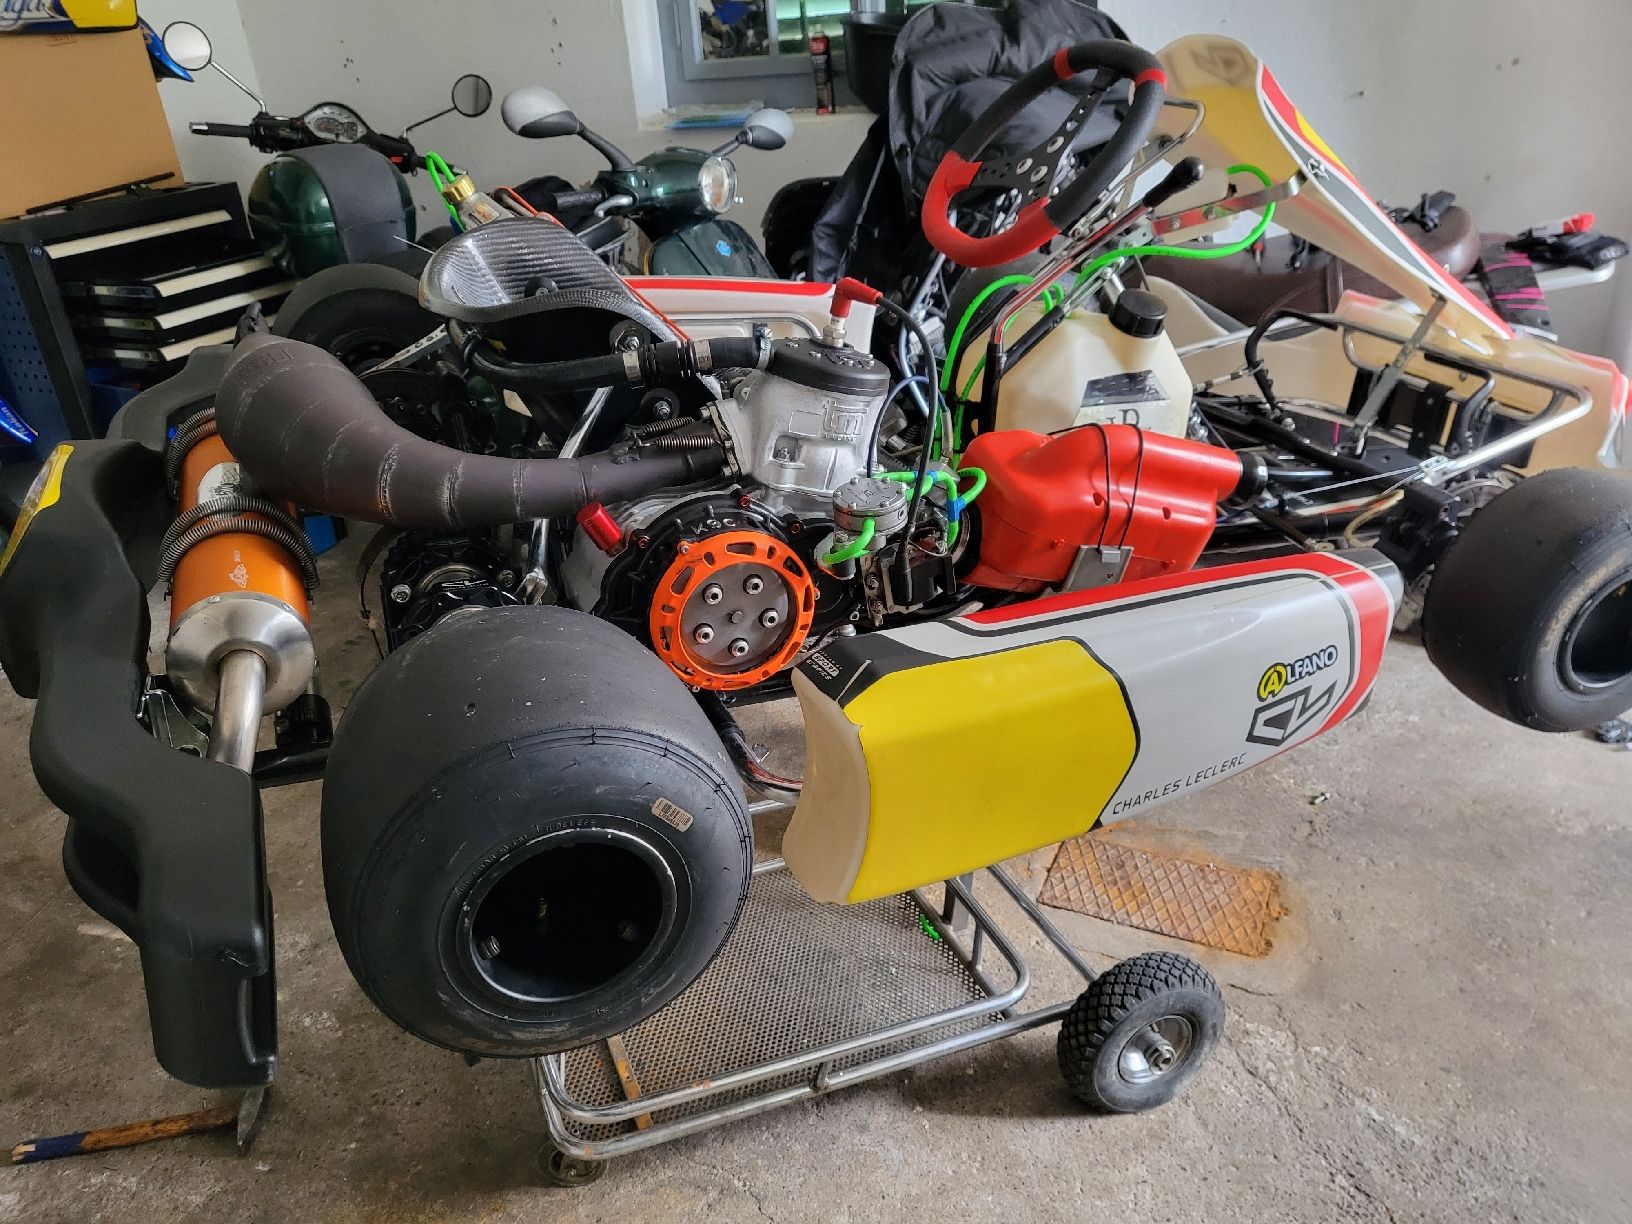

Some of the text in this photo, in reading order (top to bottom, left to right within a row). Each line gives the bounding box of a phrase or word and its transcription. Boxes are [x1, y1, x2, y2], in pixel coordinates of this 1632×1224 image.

[813, 654, 838, 674] SPORT
[1257, 645, 1339, 702] ALFANO
[1112, 752, 1247, 815] CHARLES LECLERC
